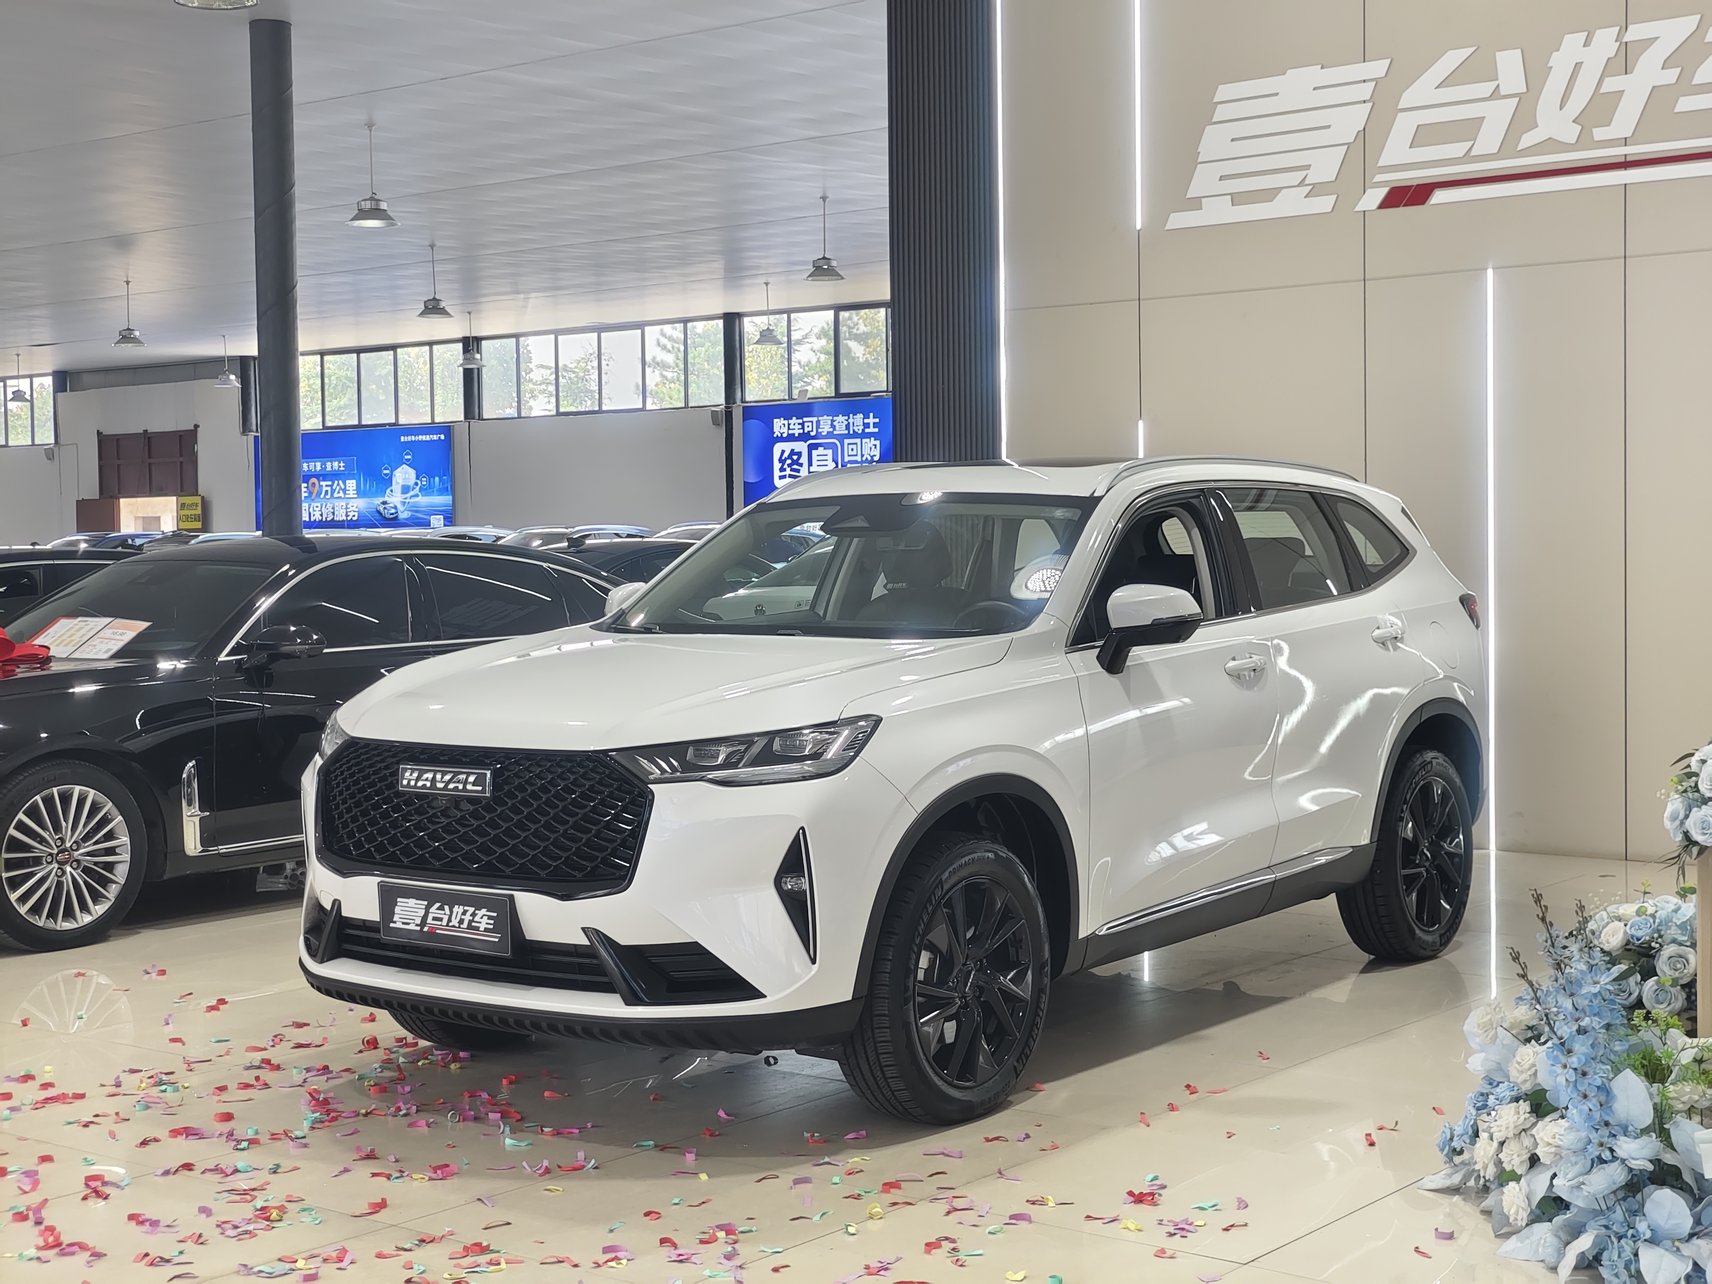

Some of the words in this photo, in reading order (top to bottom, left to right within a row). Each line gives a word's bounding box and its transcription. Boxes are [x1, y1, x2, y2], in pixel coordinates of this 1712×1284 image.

[773, 412, 880, 438] 购车可享查博士
[843, 437, 881, 462] 回购
[402, 769, 483, 791] HAVAL
[389, 897, 498, 931] 壹台好车
